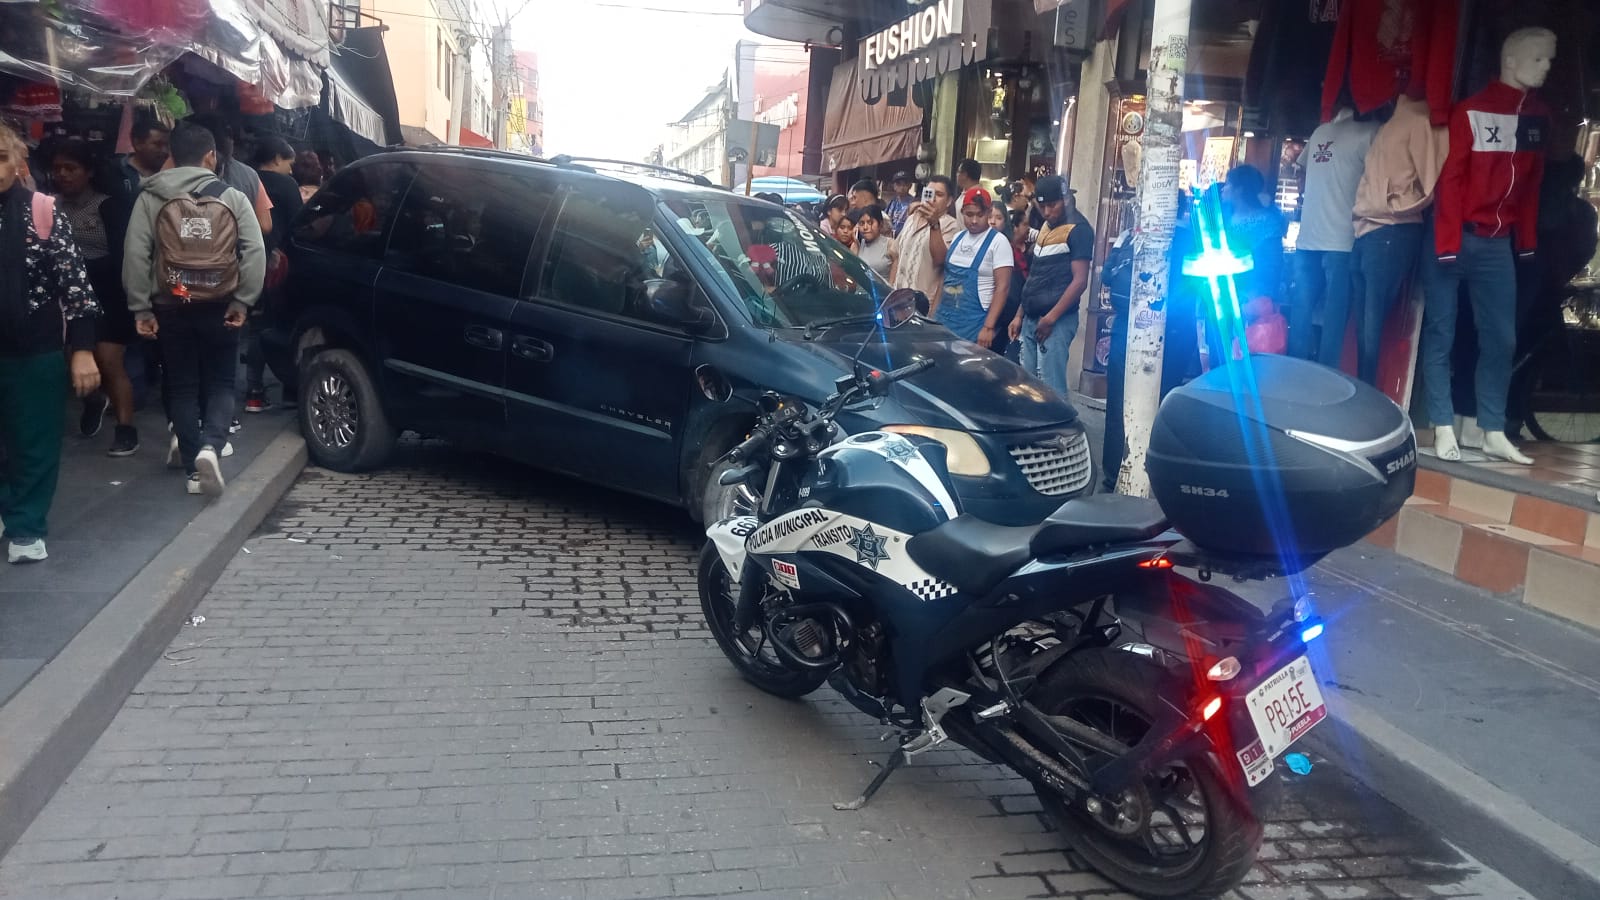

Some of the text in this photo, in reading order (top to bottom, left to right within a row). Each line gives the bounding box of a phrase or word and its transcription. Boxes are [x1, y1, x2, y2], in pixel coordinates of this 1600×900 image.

[865, 0, 953, 70] FUSHION
[1180, 484, 1230, 498] SH34
[774, 508, 829, 540] MUNICIPAL
[1264, 671, 1288, 693] PATRULLA
